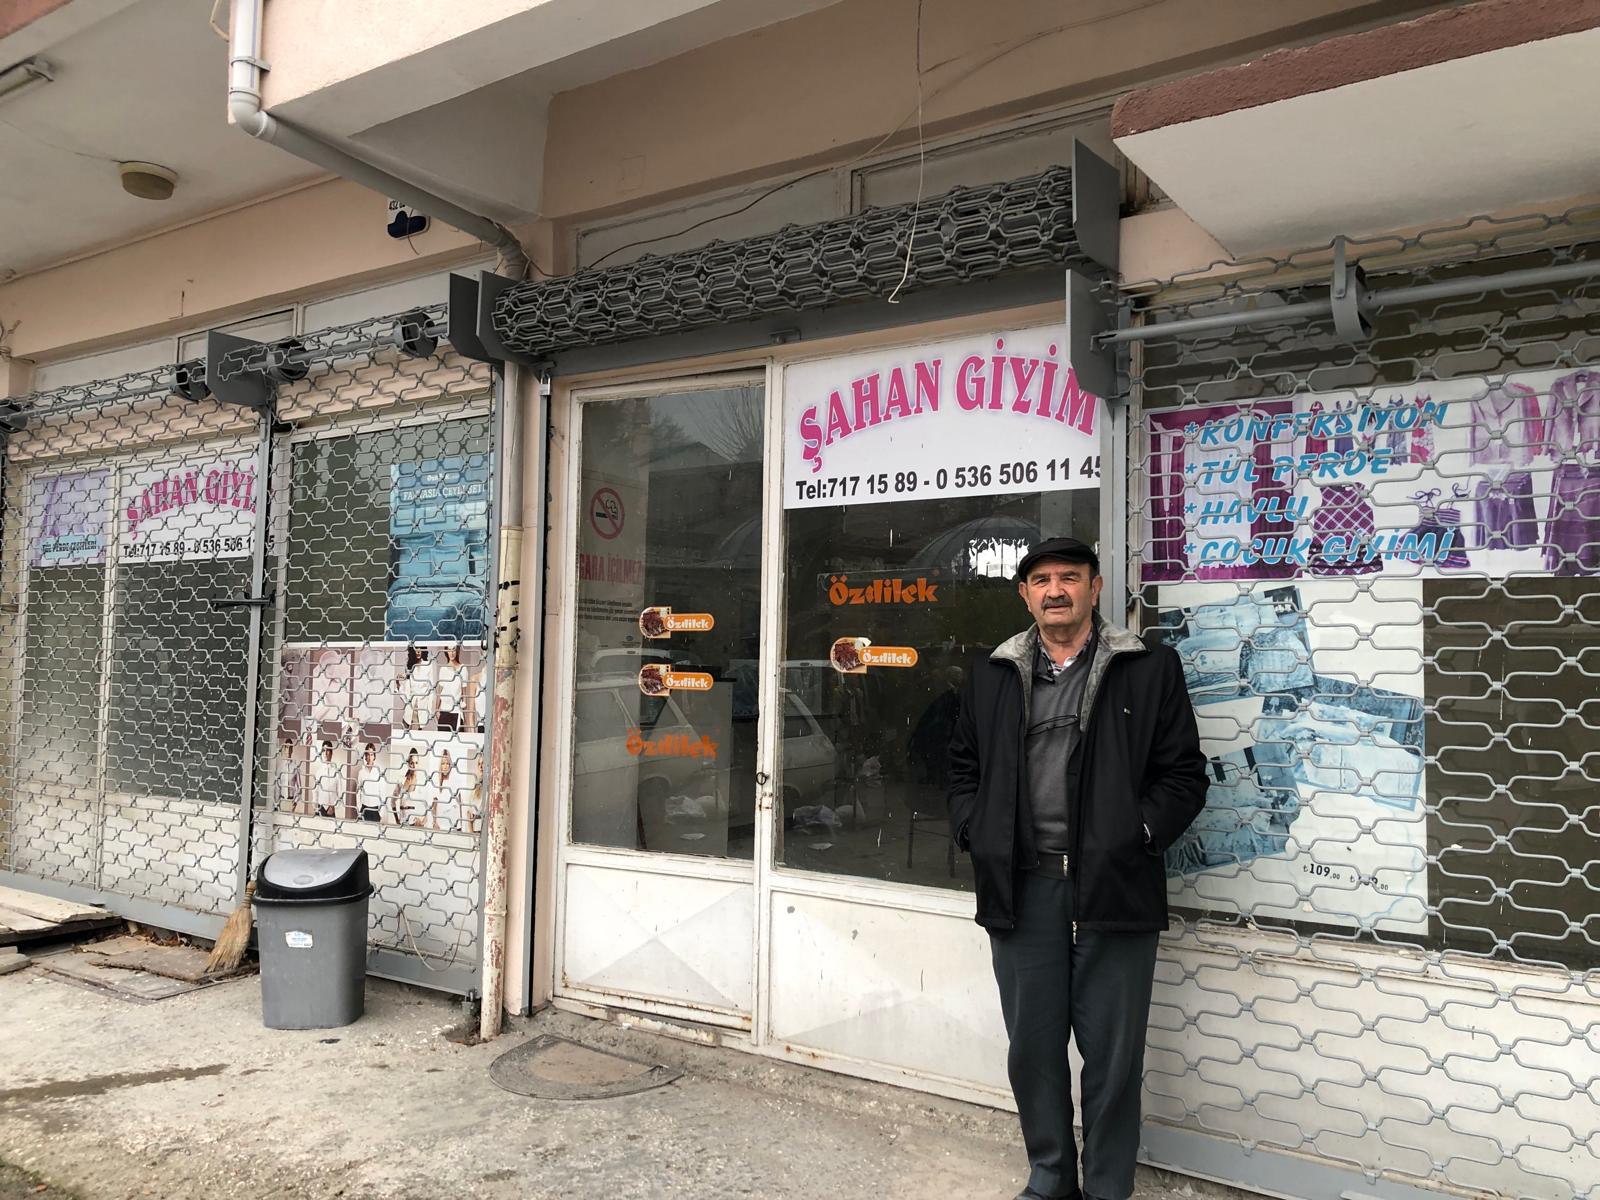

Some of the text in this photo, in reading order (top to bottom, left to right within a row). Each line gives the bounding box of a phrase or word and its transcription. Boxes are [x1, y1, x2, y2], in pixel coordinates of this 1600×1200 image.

[800, 338, 1097, 473] ŞAHAN GİYİM
[796, 477, 860, 500] Tel:717
[866, 474, 888, 495] 15
[895, 471, 917, 492] 89
[936, 469, 948, 490] 0
[954, 465, 992, 488] 536
[999, 461, 1038, 485] 506
[1046, 458, 1070, 481] 11
[1273, 448, 1392, 481] PERDE
[205, 461, 257, 514] GİYİ
[203, 538, 221, 553] 536
[829, 575, 938, 605] Özdilek
[666, 616, 709, 629] Özdilek
[862, 649, 911, 664] Özdilek
[666, 674, 709, 688] Özdilek
[626, 728, 719, 759] Özdilek
